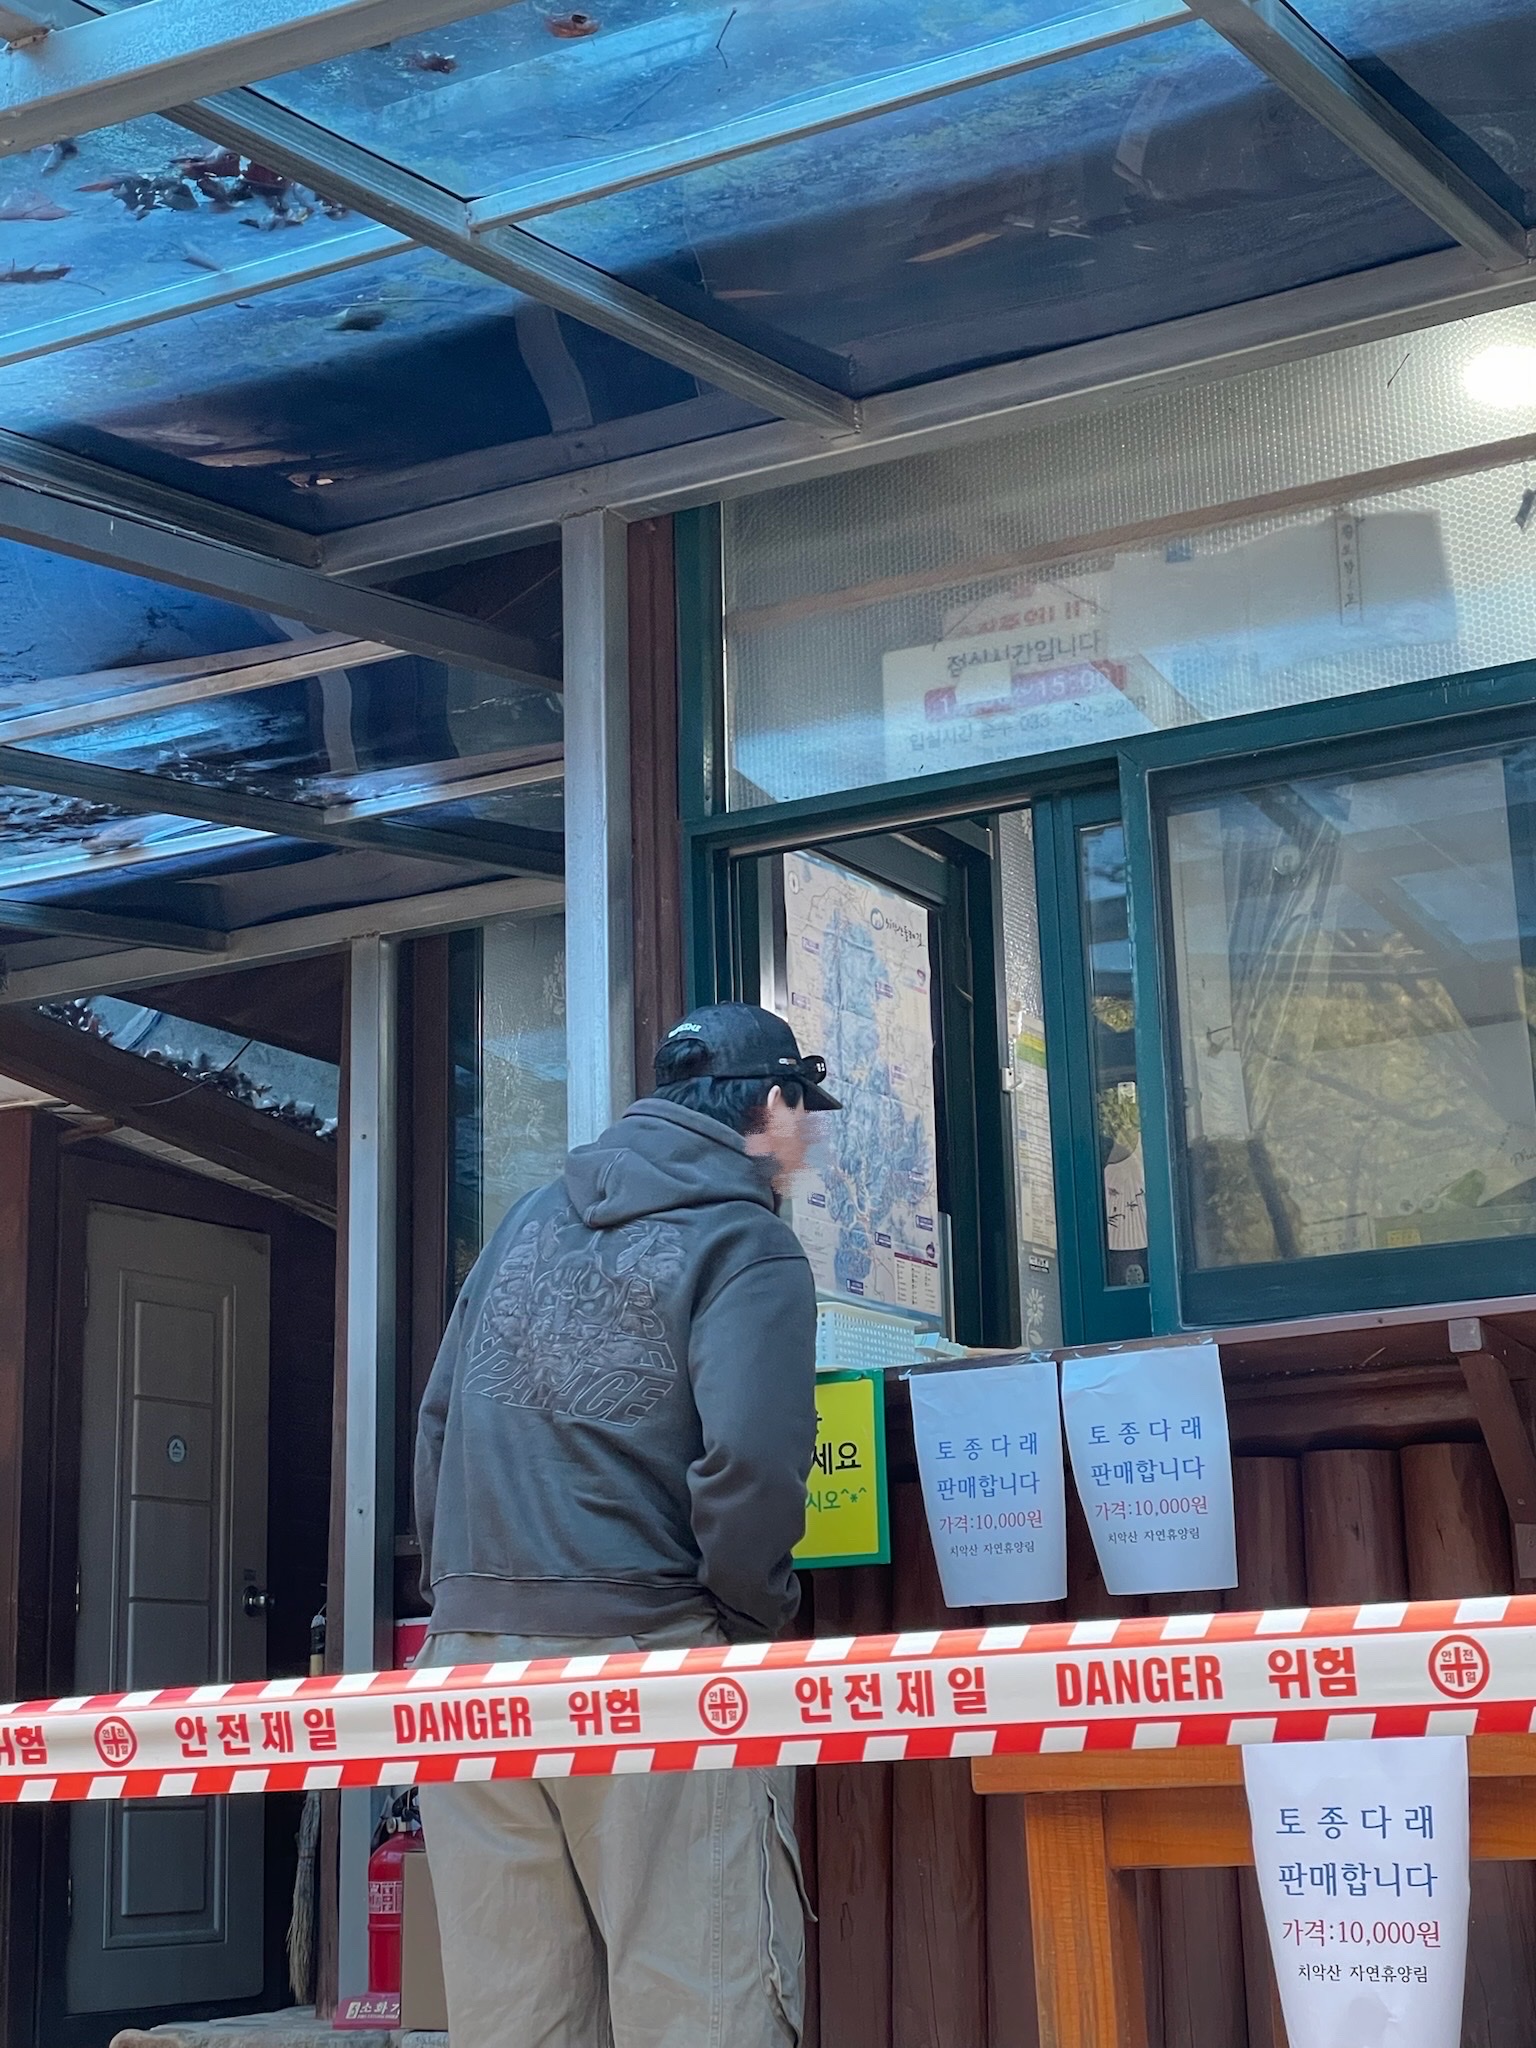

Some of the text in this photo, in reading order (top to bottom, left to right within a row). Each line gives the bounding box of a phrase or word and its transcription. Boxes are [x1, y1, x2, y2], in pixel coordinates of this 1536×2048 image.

[1091, 1456, 1205, 1486] 판매합니다
[937, 1471, 1040, 1500] 판매합니다
[1095, 1496, 1208, 1521] 가격:10,000원
[938, 1510, 1042, 1535] 가격:10,000원
[1108, 1527, 1200, 1545] 치악산 자연휴양림
[951, 1541, 1035, 1558] 치악산 자연휴양림
[393, 1696, 533, 1744] DANGER
[569, 1689, 641, 1736] 위험
[1056, 1655, 1222, 1706] DANGER
[1268, 1647, 1357, 1699] 위험
[1279, 1862, 1438, 1897] 판매합니다
[1283, 1919, 1441, 1948] 가격:10,000원
[1299, 1964, 1427, 1983] 치악산 자연휴양림
